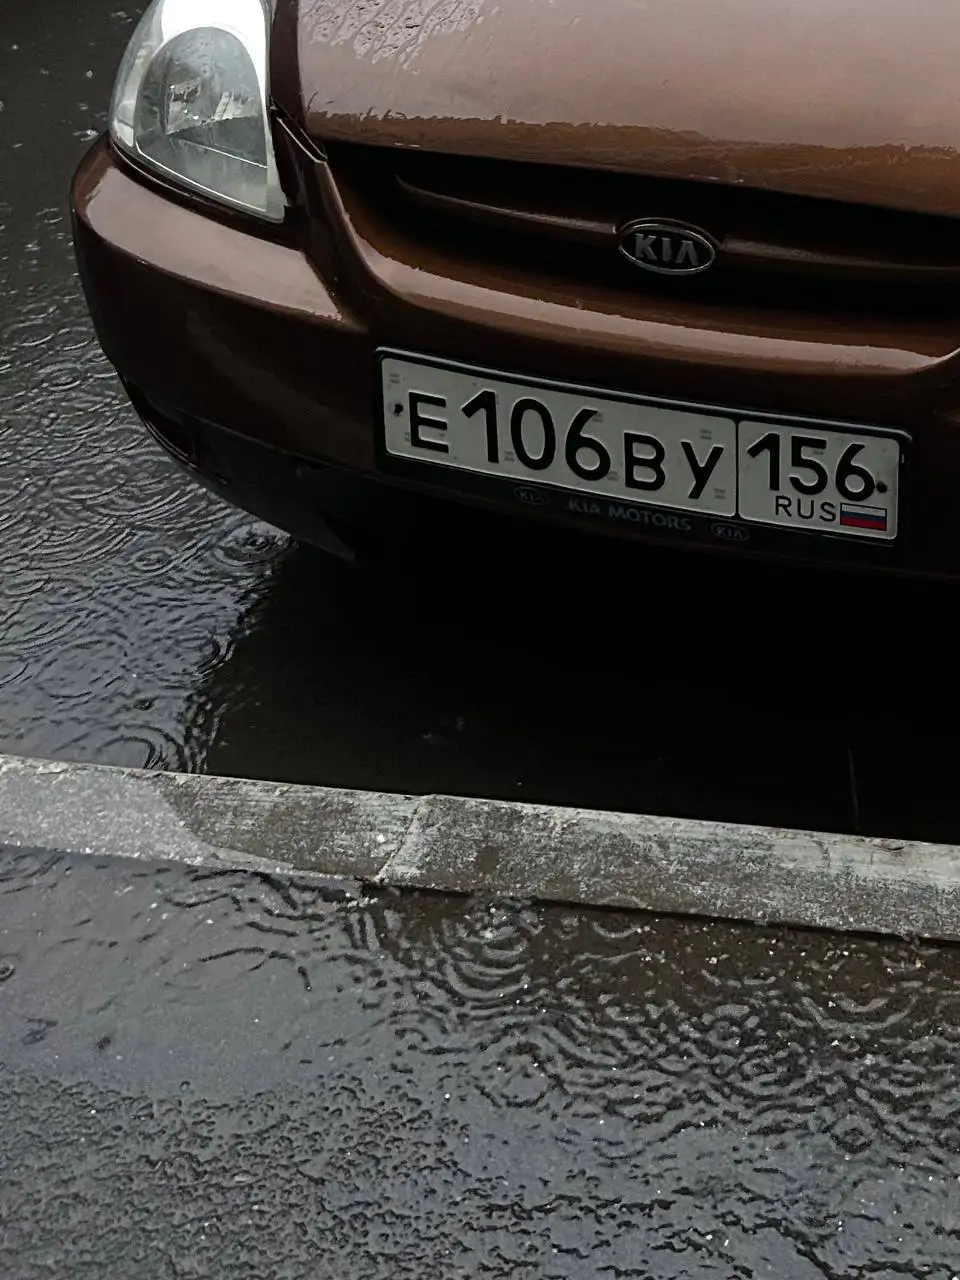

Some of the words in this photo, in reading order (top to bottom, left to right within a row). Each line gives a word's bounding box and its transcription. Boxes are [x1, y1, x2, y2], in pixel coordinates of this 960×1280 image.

[634, 233, 699, 266] KIA
[408, 389, 724, 500] Е106ВУ
[746, 431, 876, 502] 156
[568, 497, 601, 515] KIA
[608, 504, 692, 532] MOTORS
[775, 495, 837, 523] RUS
